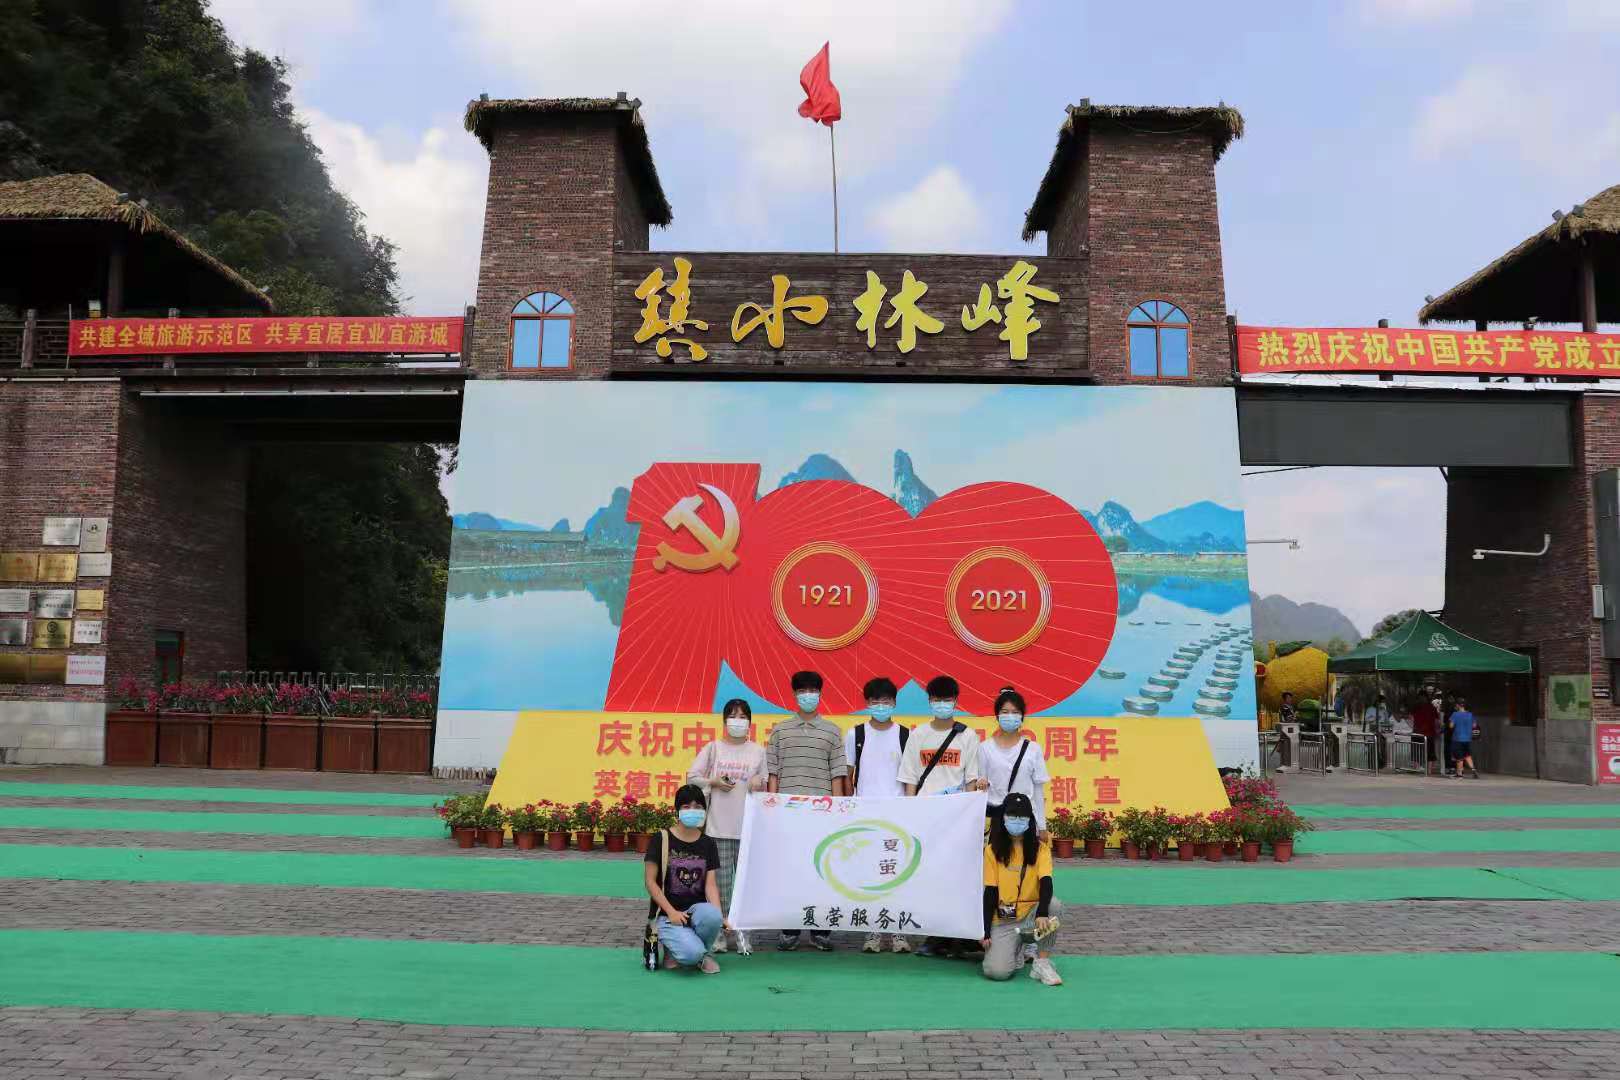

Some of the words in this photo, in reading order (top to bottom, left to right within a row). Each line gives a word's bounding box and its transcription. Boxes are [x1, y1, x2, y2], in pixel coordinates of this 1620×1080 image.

[79, 322, 253, 350] 共建全域旅游示范区
[265, 320, 449, 346] 共享宜居宜业宜游城
[1257, 330, 1620, 371] 热烈庆祝中国共产党成立
[798, 584, 854, 607] 1921
[970, 589, 1028, 611] 2021
